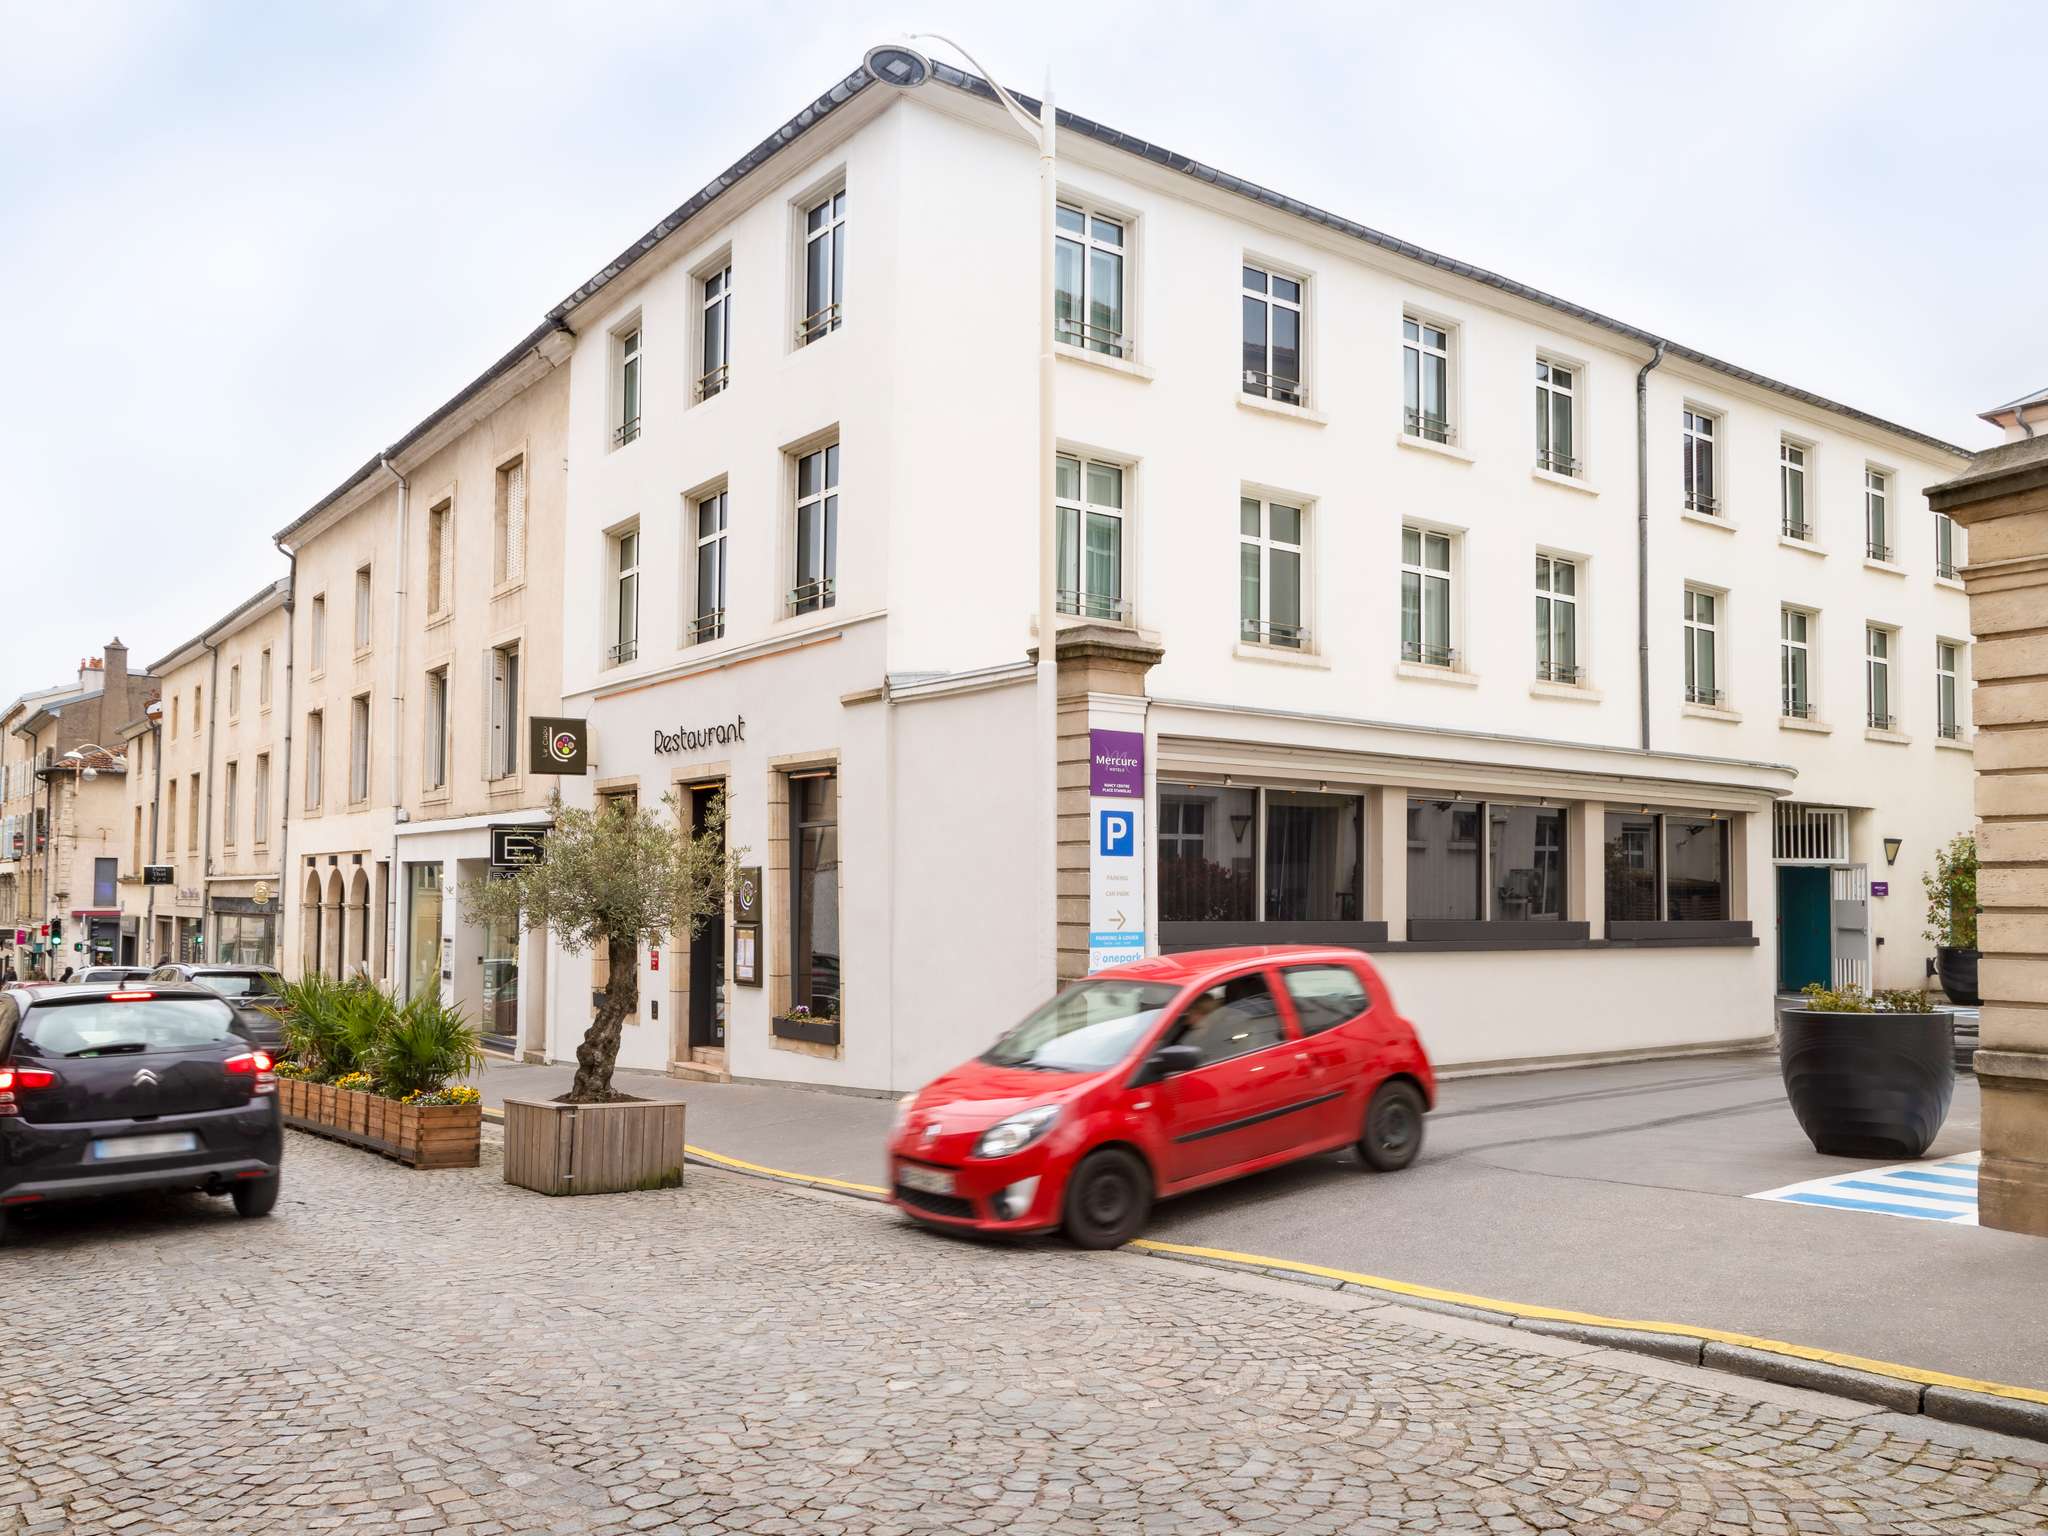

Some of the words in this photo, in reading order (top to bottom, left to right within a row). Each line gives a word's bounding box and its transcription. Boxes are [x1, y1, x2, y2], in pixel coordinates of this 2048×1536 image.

[653, 714, 745, 755] Restaurant
[1096, 754, 1138, 767] Mercure
[1107, 816, 1127, 850] P
